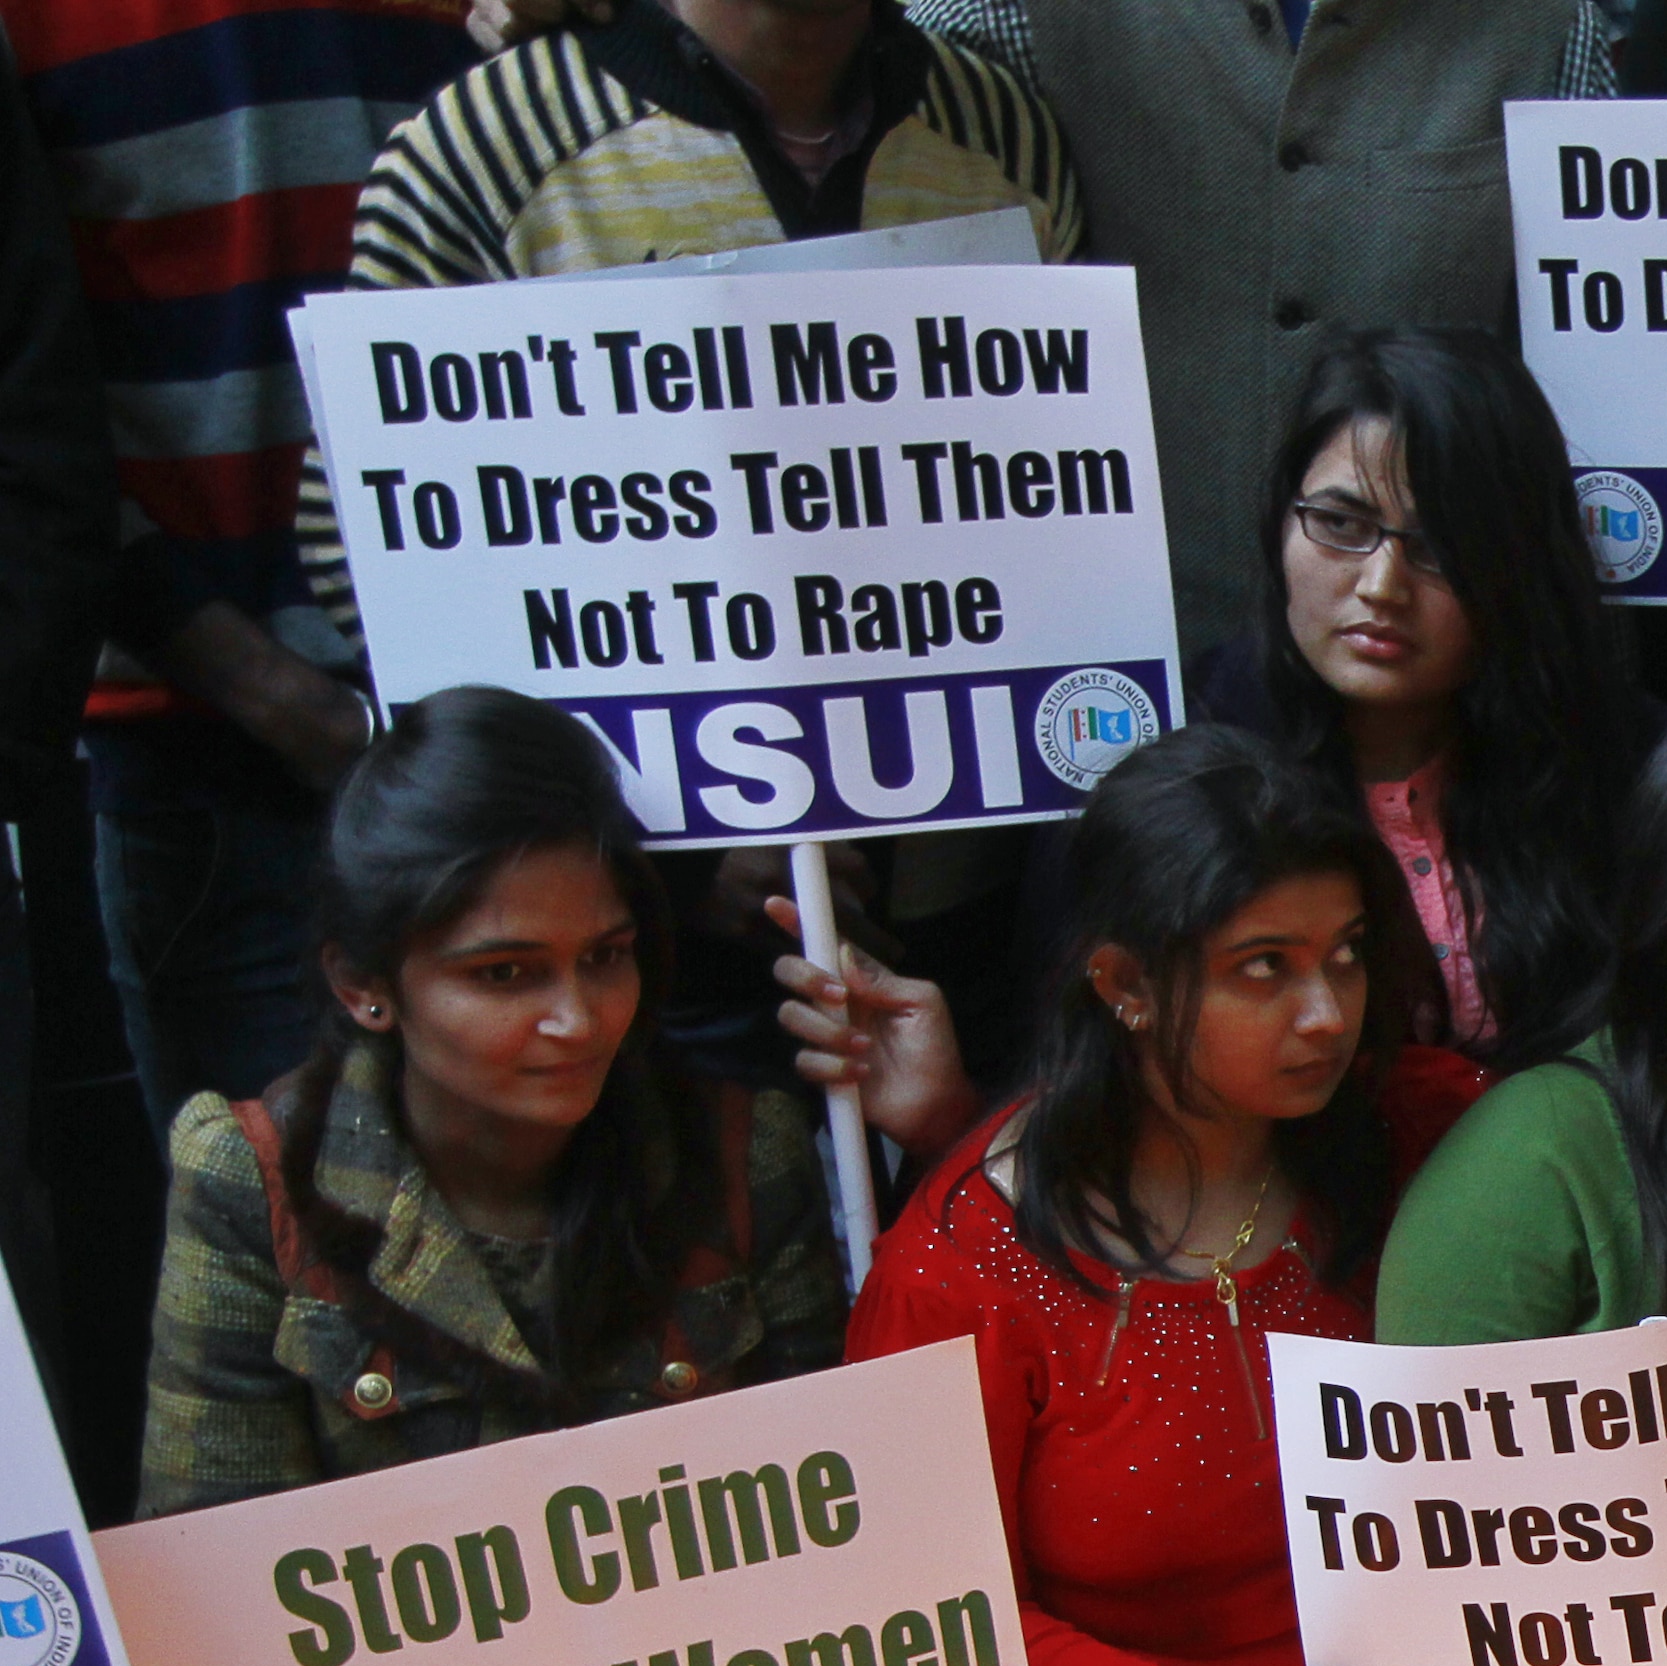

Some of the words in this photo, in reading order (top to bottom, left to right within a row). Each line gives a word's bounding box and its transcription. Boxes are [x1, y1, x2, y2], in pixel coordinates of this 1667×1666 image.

[1539, 259, 1623, 332] To
[370, 335, 585, 424] Don't
[594, 326, 753, 414] Tell
[770, 322, 897, 406] Me
[916, 316, 1088, 398] How
[361, 469, 461, 550] To
[477, 465, 717, 546] Dress
[730, 446, 887, 534] Tell
[901, 441, 1133, 523] Them
[524, 588, 663, 669] Not
[673, 582, 775, 662] To
[794, 575, 1003, 657] Rape
[1320, 1383, 1523, 1463] Don't
[545, 1451, 860, 1605] Crime
[1306, 1496, 1400, 1571] To
[1415, 1498, 1653, 1569] Dress
